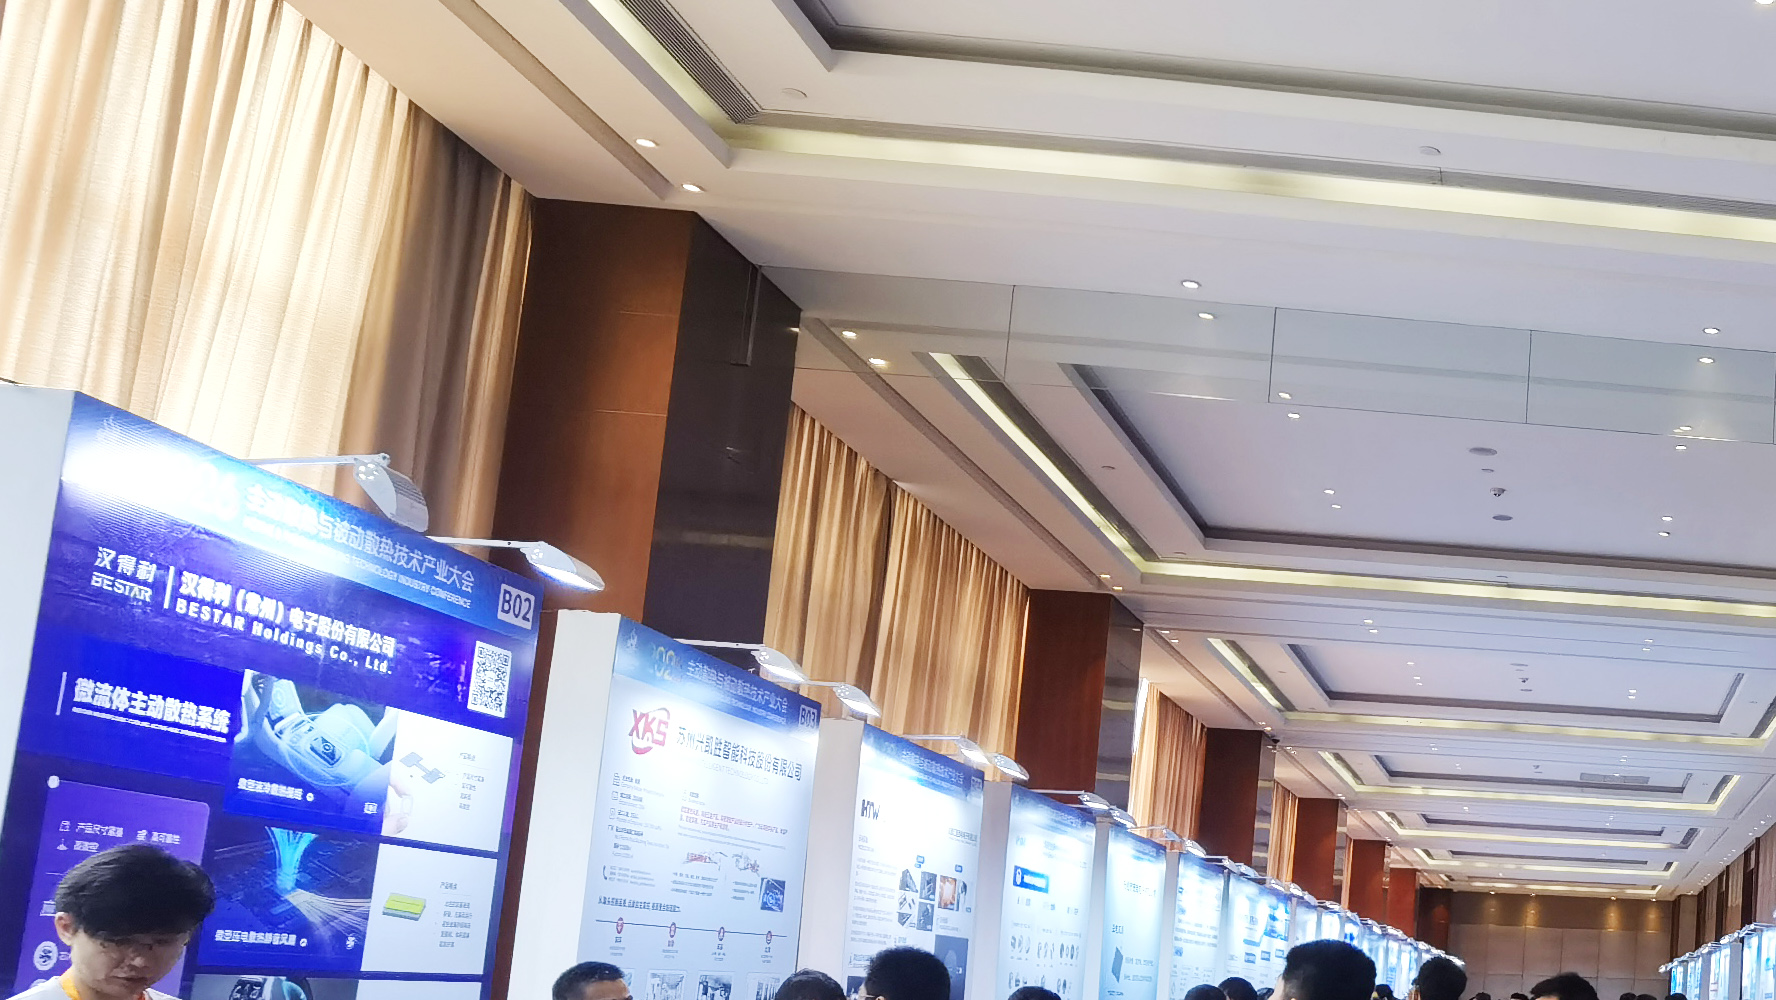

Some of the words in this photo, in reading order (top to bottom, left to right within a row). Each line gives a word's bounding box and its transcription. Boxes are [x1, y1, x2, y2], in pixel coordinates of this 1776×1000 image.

[93, 546, 158, 583] 汉得利
[90, 571, 153, 603] BESTAR
[500, 588, 533, 623] B02
[175, 597, 245, 631] BESTAR
[251, 621, 324, 658] Holdings
[364, 654, 393, 676] Ltd.
[72, 675, 232, 734] 微流体主动散热系统
[800, 706, 818, 729] B03
